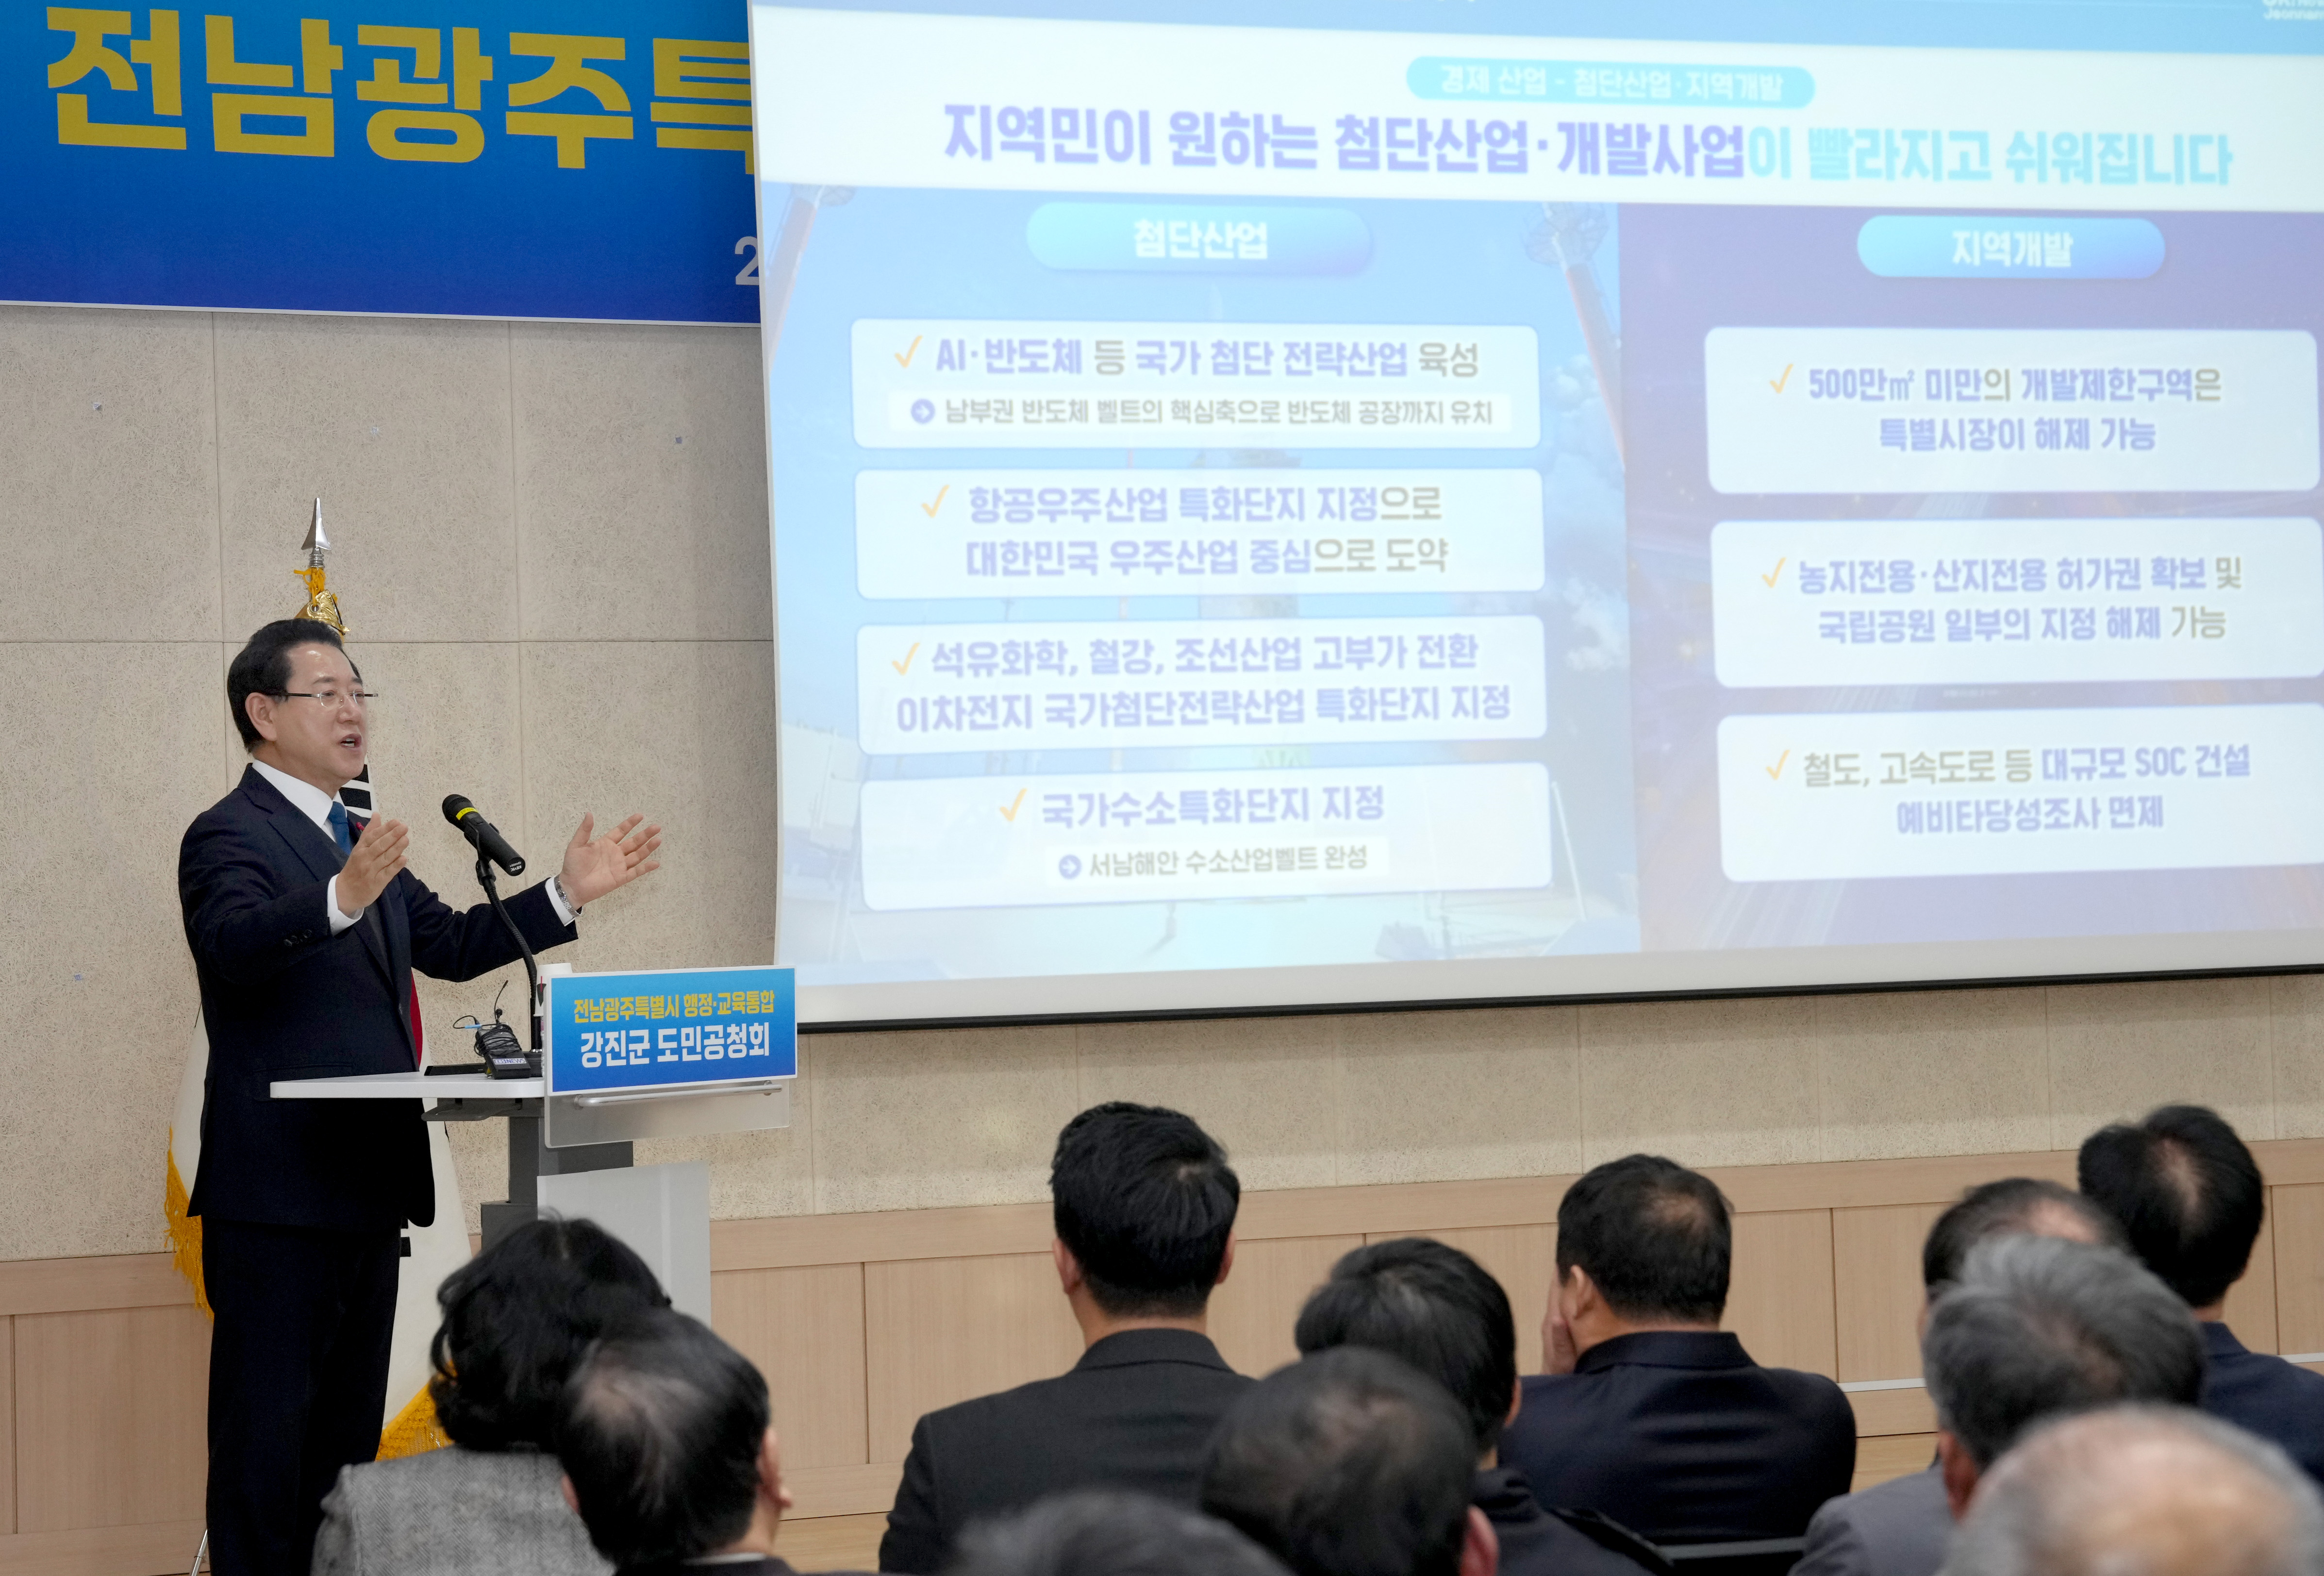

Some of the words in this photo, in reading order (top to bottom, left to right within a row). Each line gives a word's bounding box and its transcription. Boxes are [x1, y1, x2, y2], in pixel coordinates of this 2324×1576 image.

[1441, 65, 1490, 94] 경제
[1498, 67, 1547, 96] 산업
[944, 103, 1151, 166] 지역민이
[1169, 111, 1318, 168] 원하는
[1335, 114, 1791, 179] 첨단산업·개발사업이
[1808, 127, 1992, 181] 빨라지고
[2006, 130, 2234, 186] 쉬워집니다
[1134, 219, 1268, 260] 첨단산업
[1952, 230, 2074, 268] 지역개발
[936, 338, 1082, 374] AI·반도체
[1094, 339, 1125, 375] 등
[1136, 339, 1201, 375] 국가
[1211, 339, 1274, 376] 첨단
[1284, 341, 1408, 377] 전략산업
[1419, 342, 1478, 378] 육성
[1925, 368, 2010, 402] 미만의
[2021, 367, 2222, 402] 개발제한구역은
[945, 399, 1013, 424] 남부권
[1022, 399, 1089, 424] 반도체
[1097, 399, 1163, 424] 벨트의
[1171, 399, 1281, 424] 핵심축으로
[1288, 400, 1351, 424] 반도체
[1359, 400, 1444, 425] 공장까지
[1450, 400, 1493, 425] 유치
[1880, 417, 2025, 452] 특별시장이
[2035, 417, 2090, 452] 해제
[2101, 417, 2156, 452] 가능
[969, 486, 1167, 524] 항공우주산업
[1179, 486, 1305, 523] 특화단지
[1317, 486, 1443, 522] 지정으로
[966, 539, 1099, 577] 대한민국
[1110, 539, 1238, 575] 우주산업
[1250, 538, 1377, 574] 중심으로
[1386, 538, 1449, 573] 도약
[1799, 558, 2047, 595] 농지전용·산지전용
[2057, 556, 2141, 591] 허가권
[2150, 555, 2207, 591] 확보
[2215, 556, 2242, 590] 및
[1819, 608, 1936, 644] 국립공원
[1944, 607, 2031, 642] 일부의
[2041, 606, 2096, 641] 지정
[2106, 605, 2161, 640] 해제
[2171, 605, 2226, 639] 가능
[932, 639, 1079, 678] 석유화학,
[1090, 638, 1164, 675] 철강,
[1175, 637, 1301, 673] 조선산업
[1314, 635, 1408, 671] 고부가
[1417, 633, 1478, 670] 전환
[897, 693, 1033, 733] 이차전지
[1045, 688, 1305, 728] 국가첨단전략산업
[1316, 686, 1440, 722] 특화단지
[1451, 685, 1511, 721] 지정
[1804, 752, 1871, 788] 철도,
[1879, 750, 1995, 785] 고속도로
[2005, 749, 2033, 783] 등
[2042, 746, 2127, 782] 대규모
[2135, 745, 2187, 778] SOC
[2195, 743, 2251, 778] 건설
[1042, 786, 1310, 829] 국가수소특화단지
[1322, 785, 1385, 822] 지정
[1896, 796, 2101, 835] 예비타당성조사
[2108, 794, 2165, 830] 면제
[1089, 850, 1179, 878] 서남해안
[1186, 846, 1318, 874] 수소산업벨트
[1325, 844, 1368, 871] 완성
[574, 994, 679, 1023] 전남광주특별시
[683, 989, 775, 1017] 행정·교육통합
[581, 1029, 650, 1068] 강진군
[657, 1022, 770, 1063] 도민공청회
